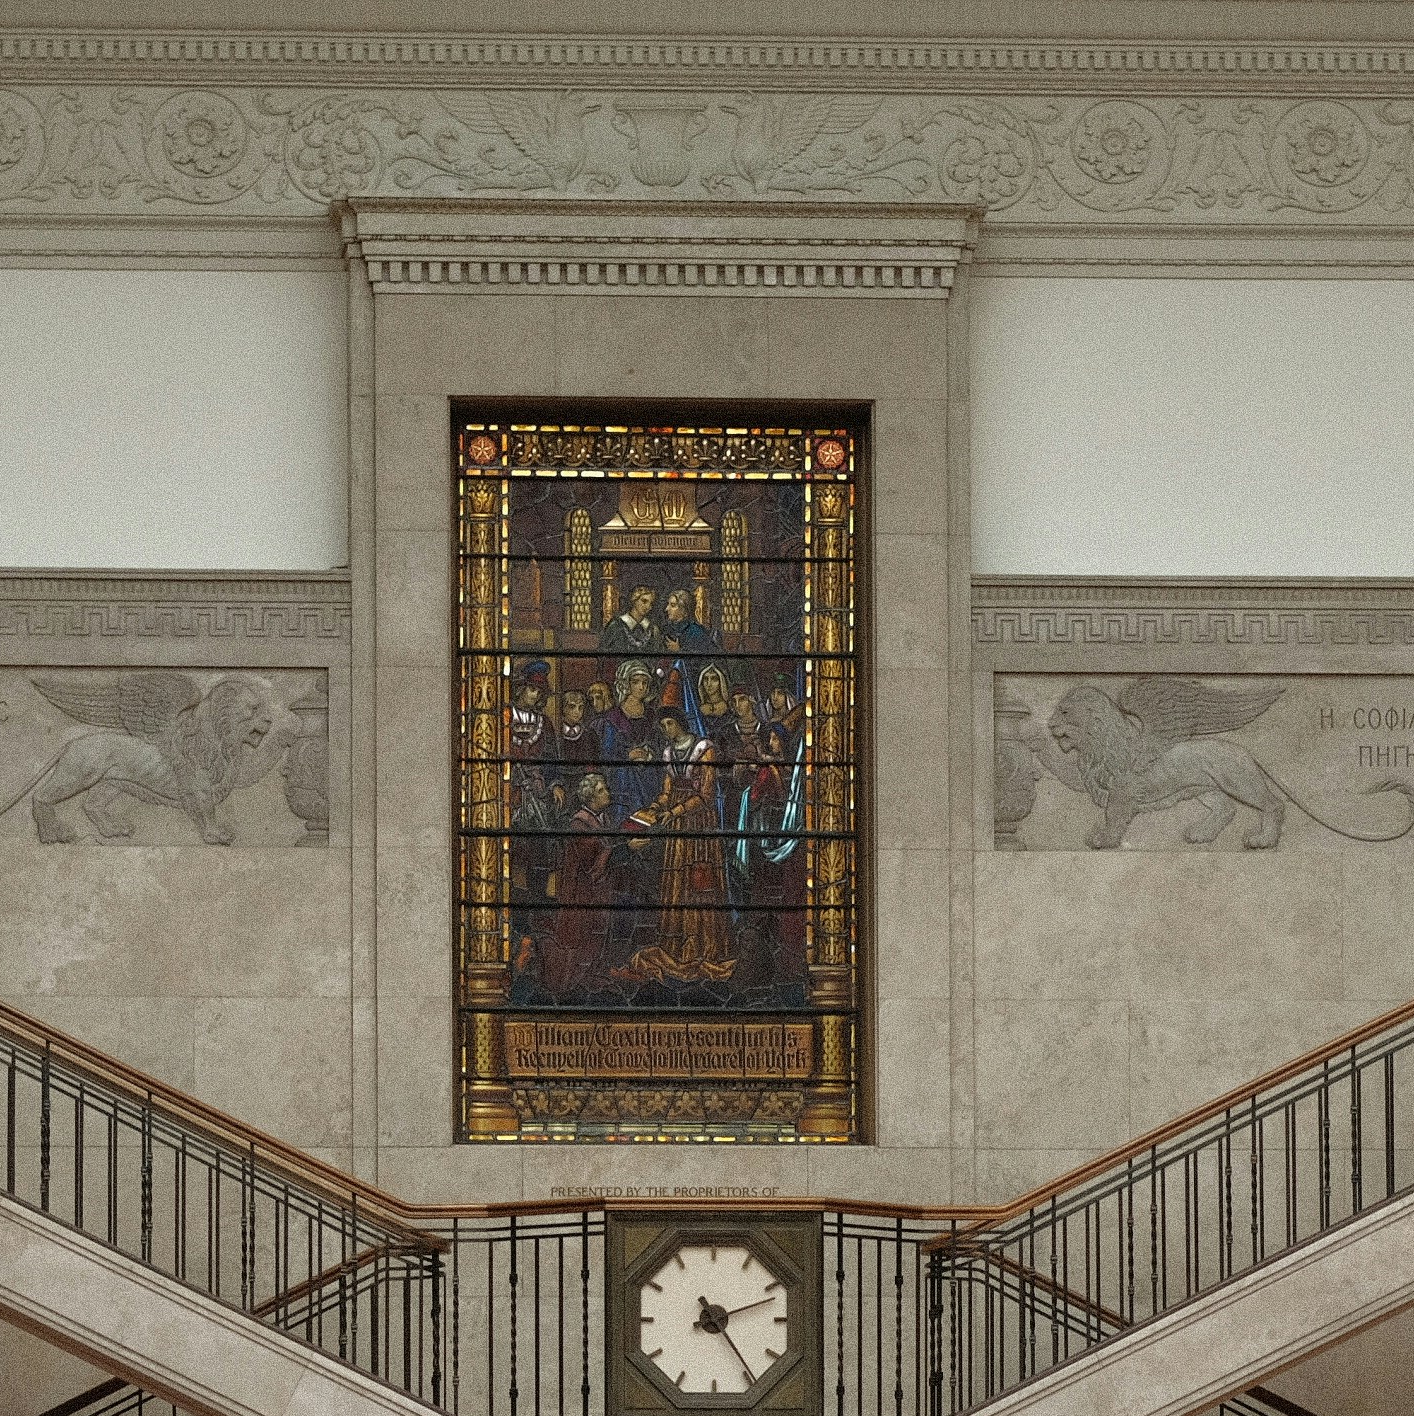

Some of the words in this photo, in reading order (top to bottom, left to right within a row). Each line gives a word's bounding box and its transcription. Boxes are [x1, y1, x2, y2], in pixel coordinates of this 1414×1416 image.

[595, 1025, 662, 1049] Caxton
[550, 1186, 623, 1198] PRESENTED
[626, 1186, 641, 1198] BY
[645, 1187, 669, 1198] THE
[673, 1187, 758, 1198] PROPRIETORS
[762, 1187, 780, 1198] OF
